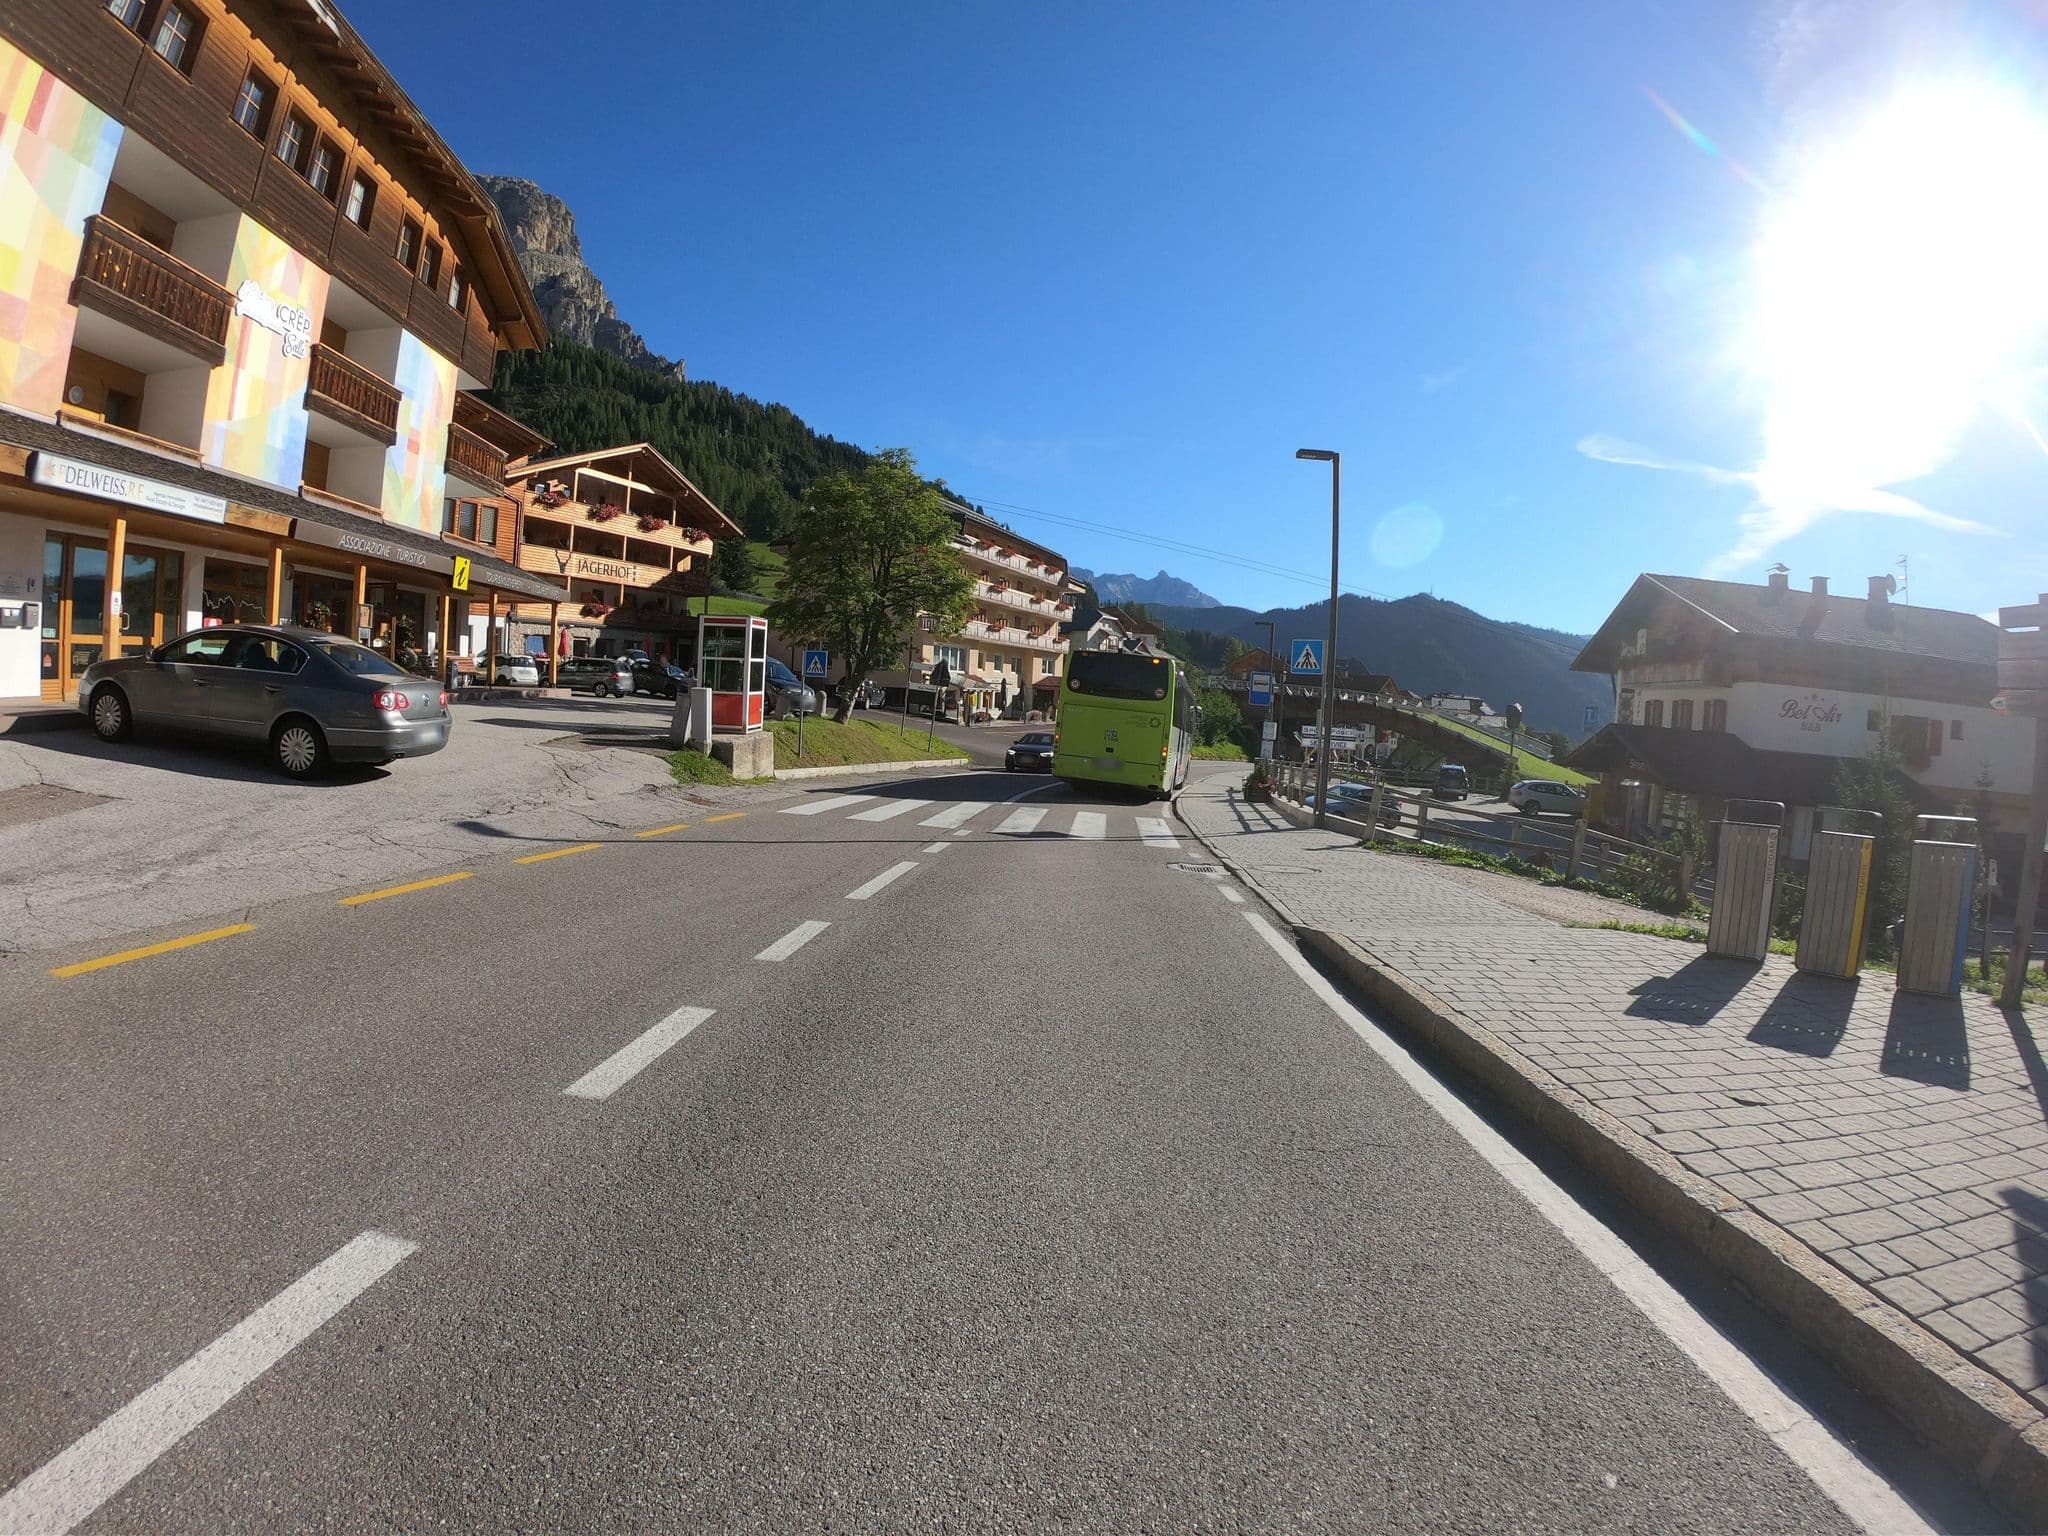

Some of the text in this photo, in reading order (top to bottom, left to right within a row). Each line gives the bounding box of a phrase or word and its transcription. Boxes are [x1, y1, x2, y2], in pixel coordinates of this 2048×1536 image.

[340, 535, 426, 566] ASSOCIAZIONE TURISTICA
[577, 557, 633, 579] JÄGERHOF
[1779, 699, 1811, 720] Bel
